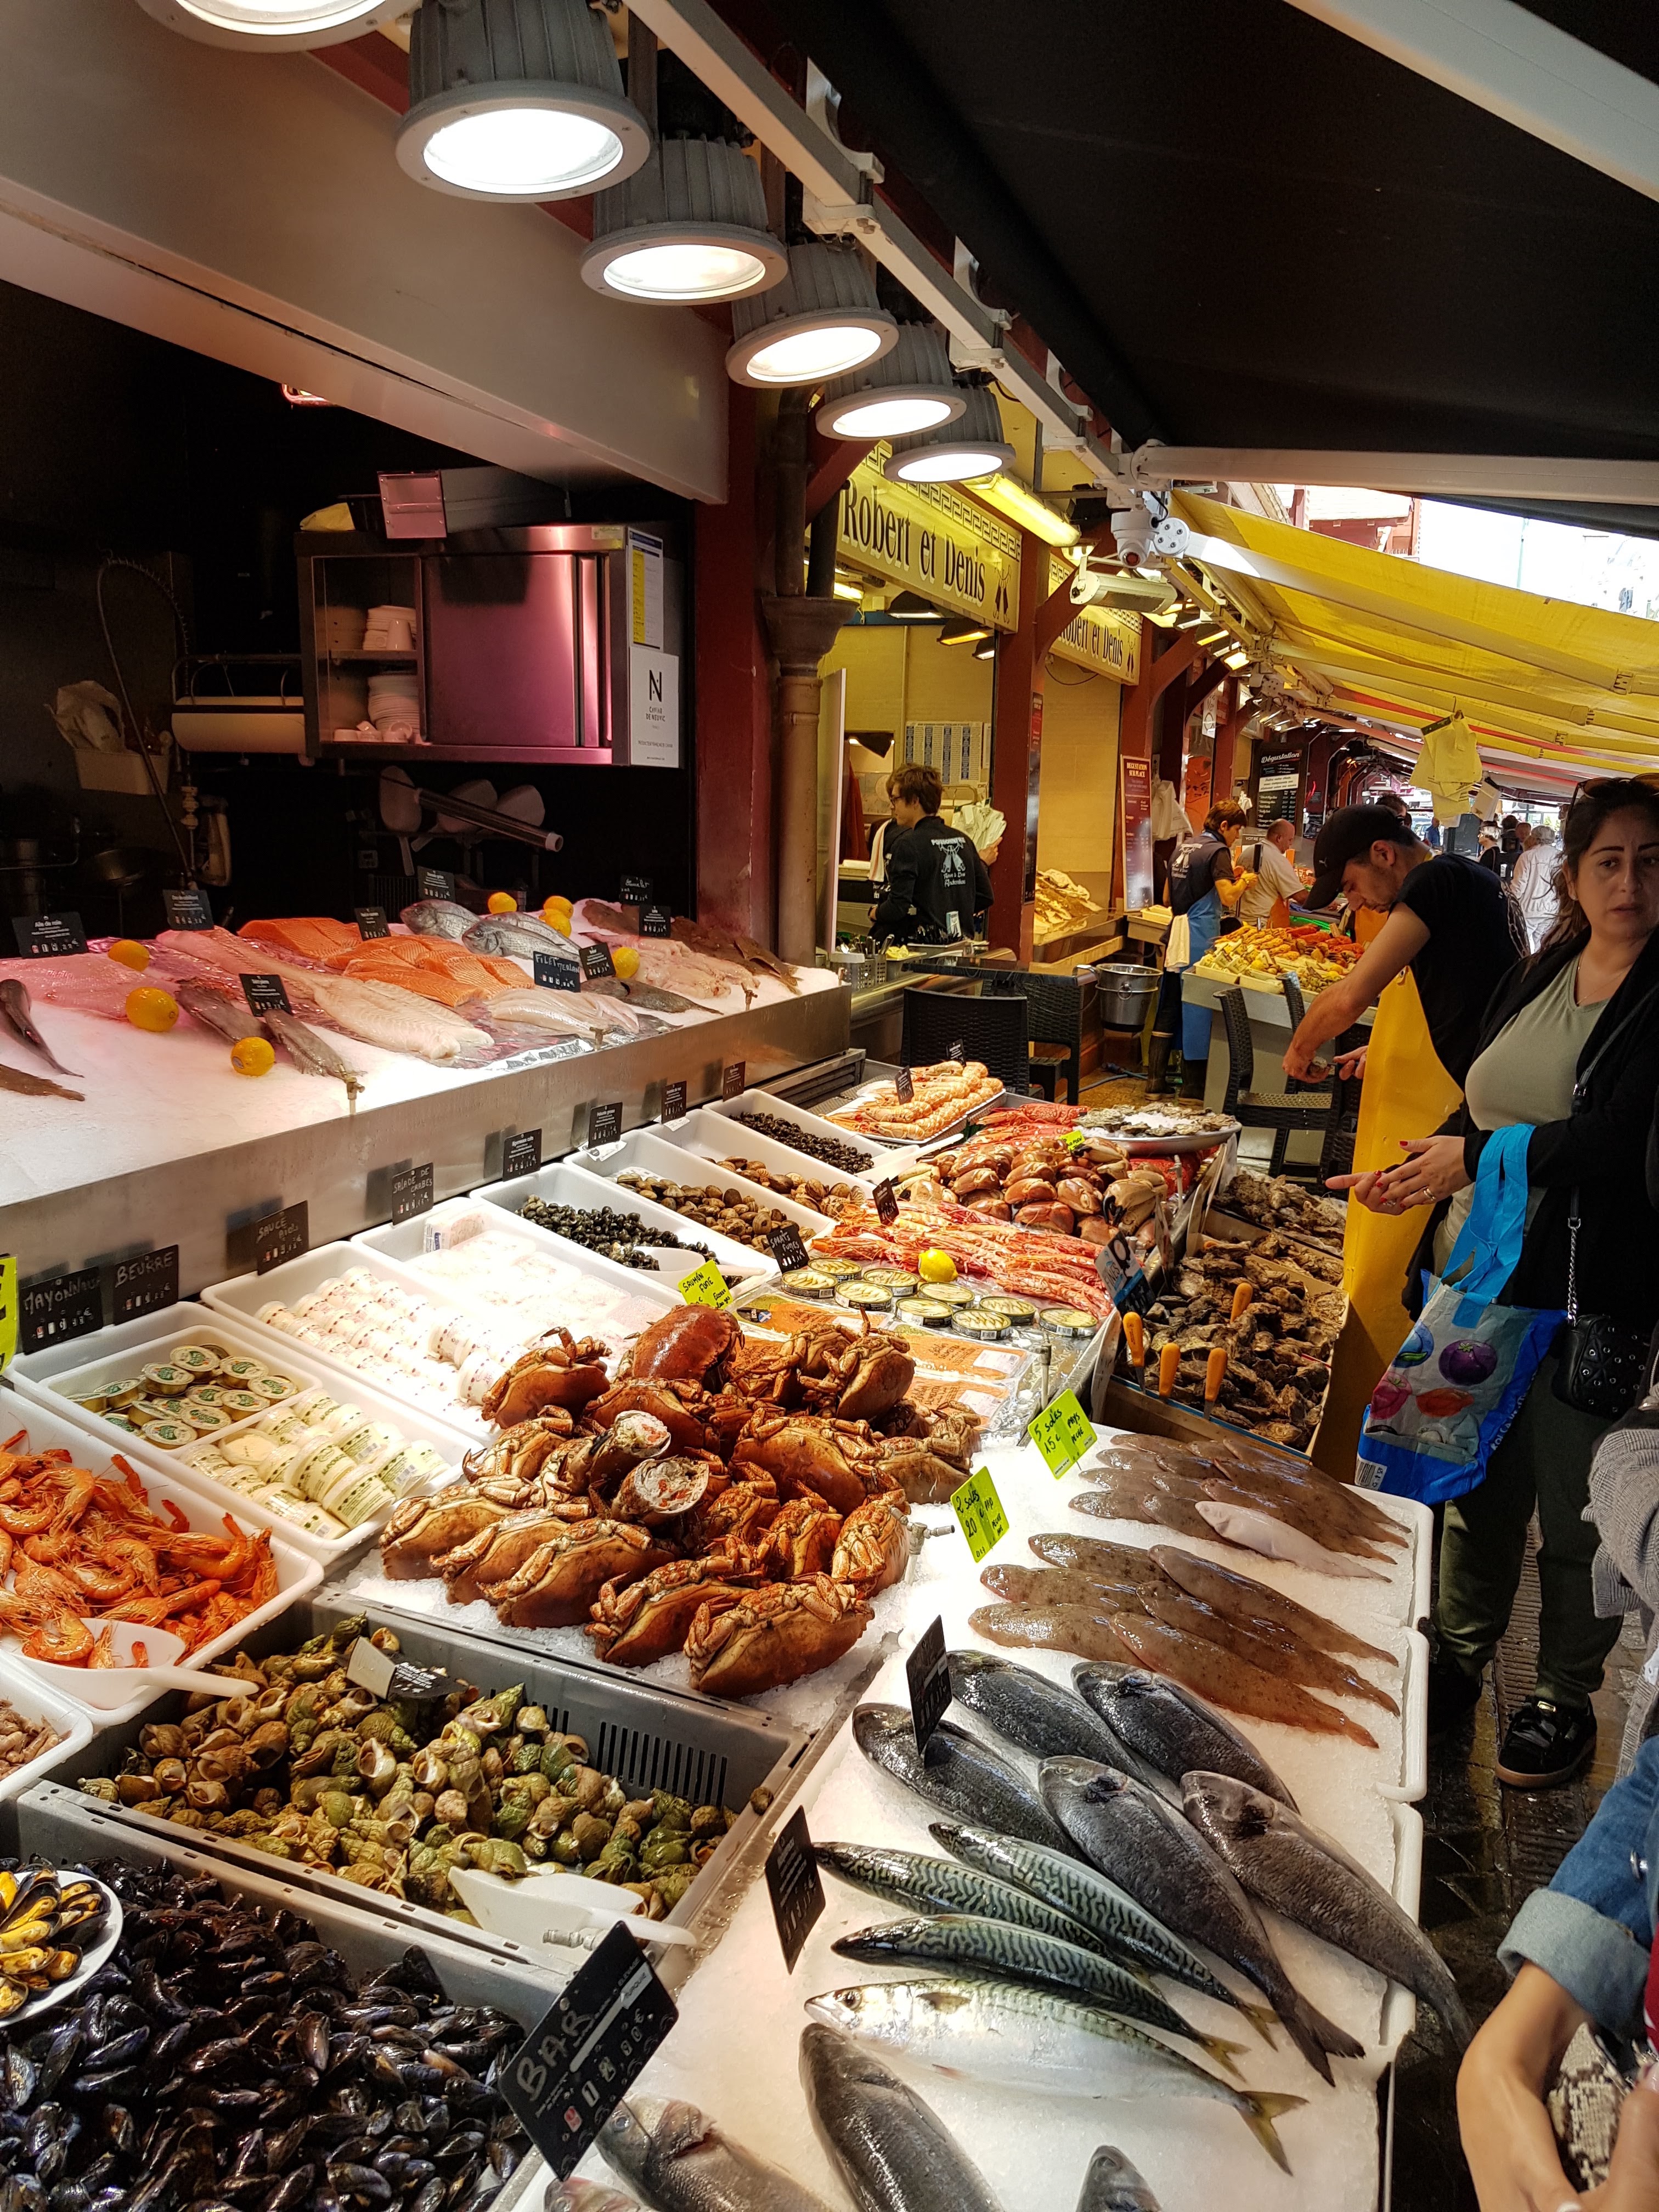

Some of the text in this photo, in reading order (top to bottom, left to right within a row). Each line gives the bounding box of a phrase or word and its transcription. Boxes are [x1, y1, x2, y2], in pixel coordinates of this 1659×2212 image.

[842, 477, 985, 607] Robert et Denis
[1091, 624, 1100, 658] et
[1102, 624, 1123, 670] Denis
[648, 669, 662, 703] N
[652, 714, 665, 722] NEUVIC
[1261, 752, 1300, 763] Dégustation
[393, 1167, 430, 1194] SALADE DE
[410, 1178, 432, 1193] CRABES
[256, 1216, 287, 1244] SAUCE
[770, 1231, 791, 1249] SPRATS
[782, 1240, 800, 1252] FUMES
[115, 1251, 174, 1288] BEURRE
[682, 1271, 704, 1293] SAUMON
[699, 1276, 714, 1293] FUME
[1034, 1408, 1062, 1442] 5 SOLES
[1066, 1412, 1081, 1431] PAYS
[956, 1488, 980, 1514] 2 SOLES
[966, 1517, 978, 1538] 20
[516, 2010, 595, 2102] BAR
